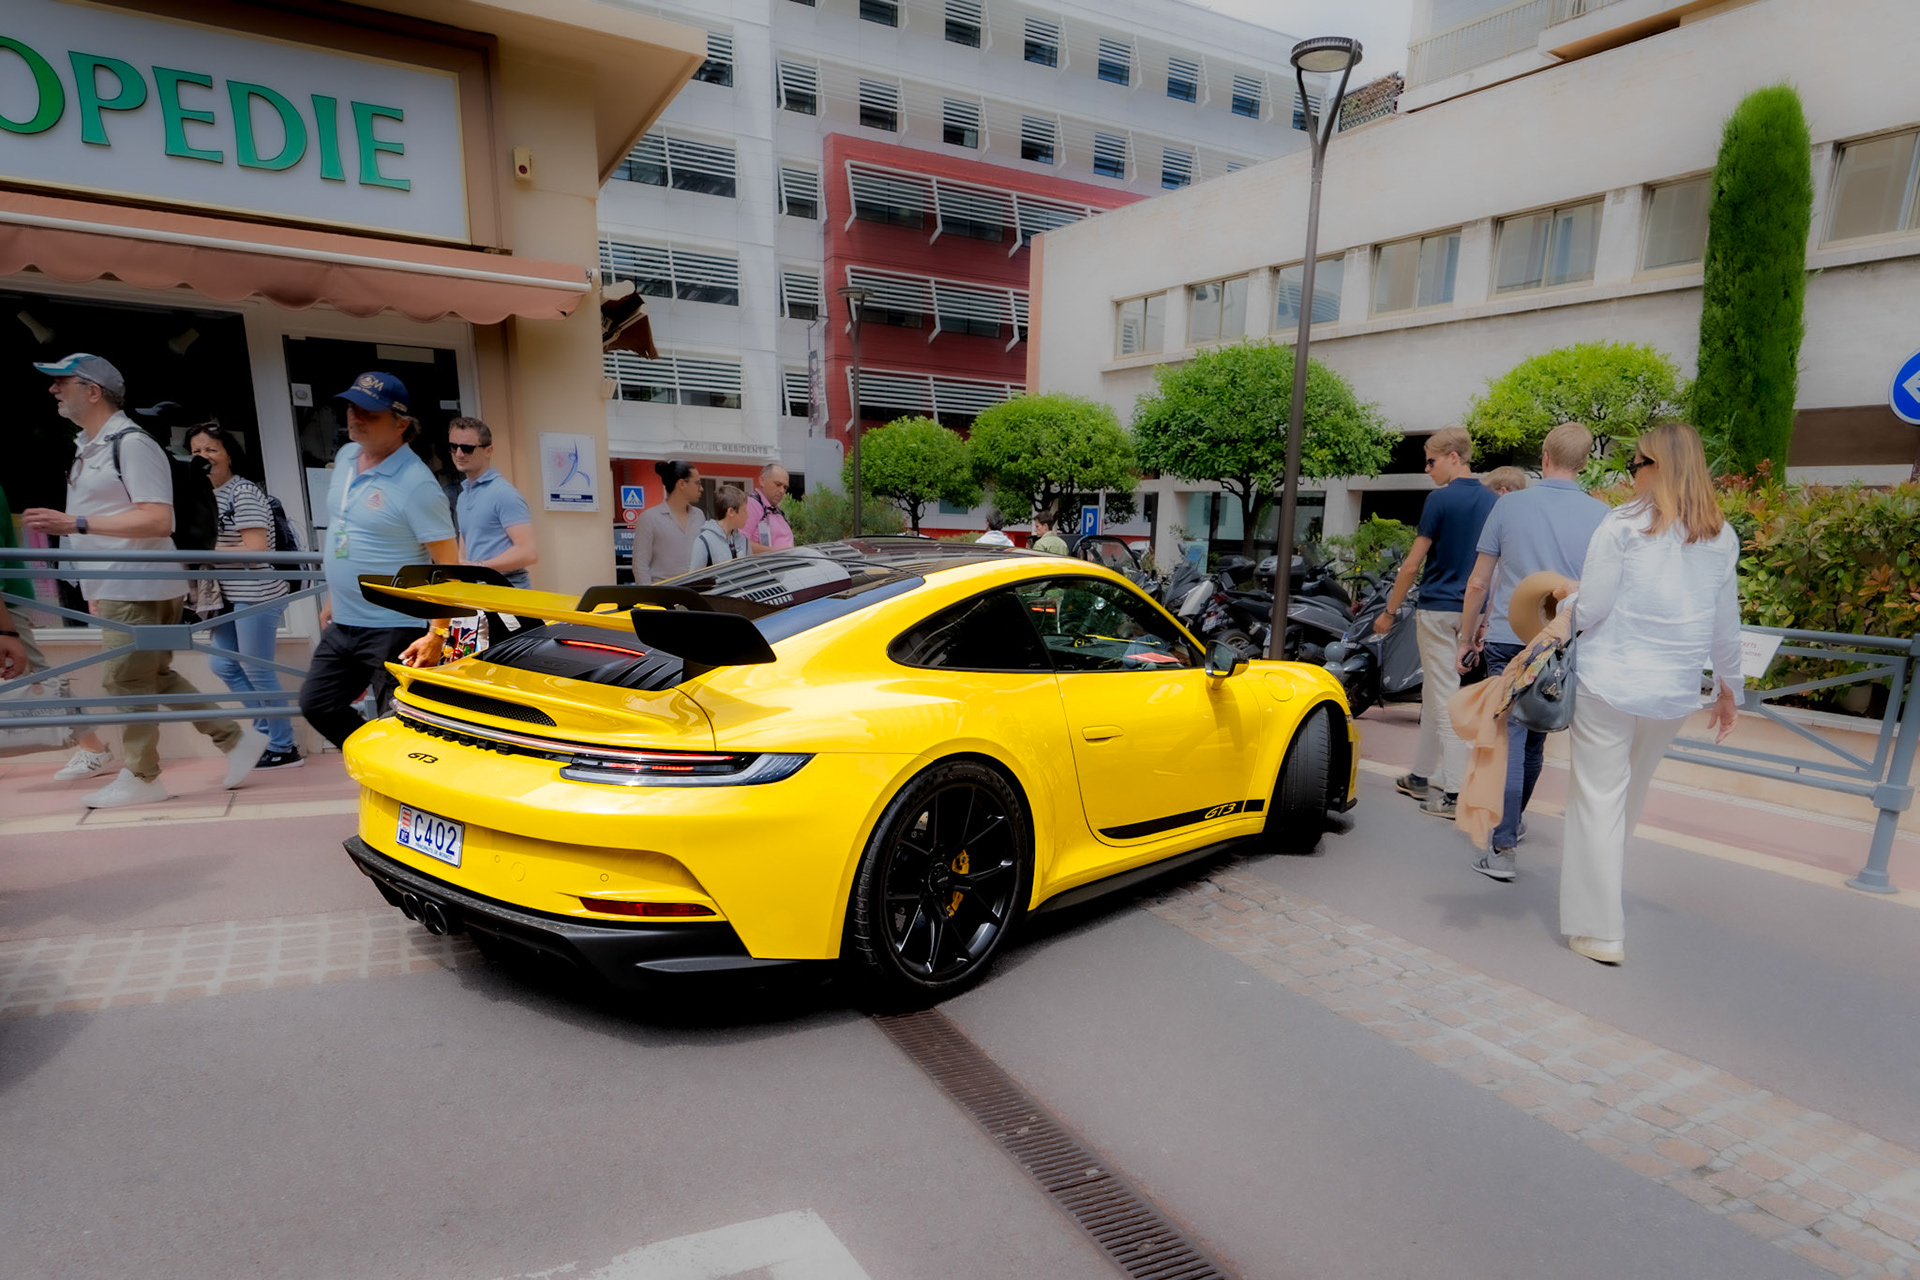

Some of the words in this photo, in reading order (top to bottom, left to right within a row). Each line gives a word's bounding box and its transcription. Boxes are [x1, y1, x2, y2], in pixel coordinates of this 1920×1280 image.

[1086, 512, 1094, 533] P
[408, 752, 438, 764] GT3
[1204, 802, 1237, 819] GT3
[414, 814, 457, 856] C402
